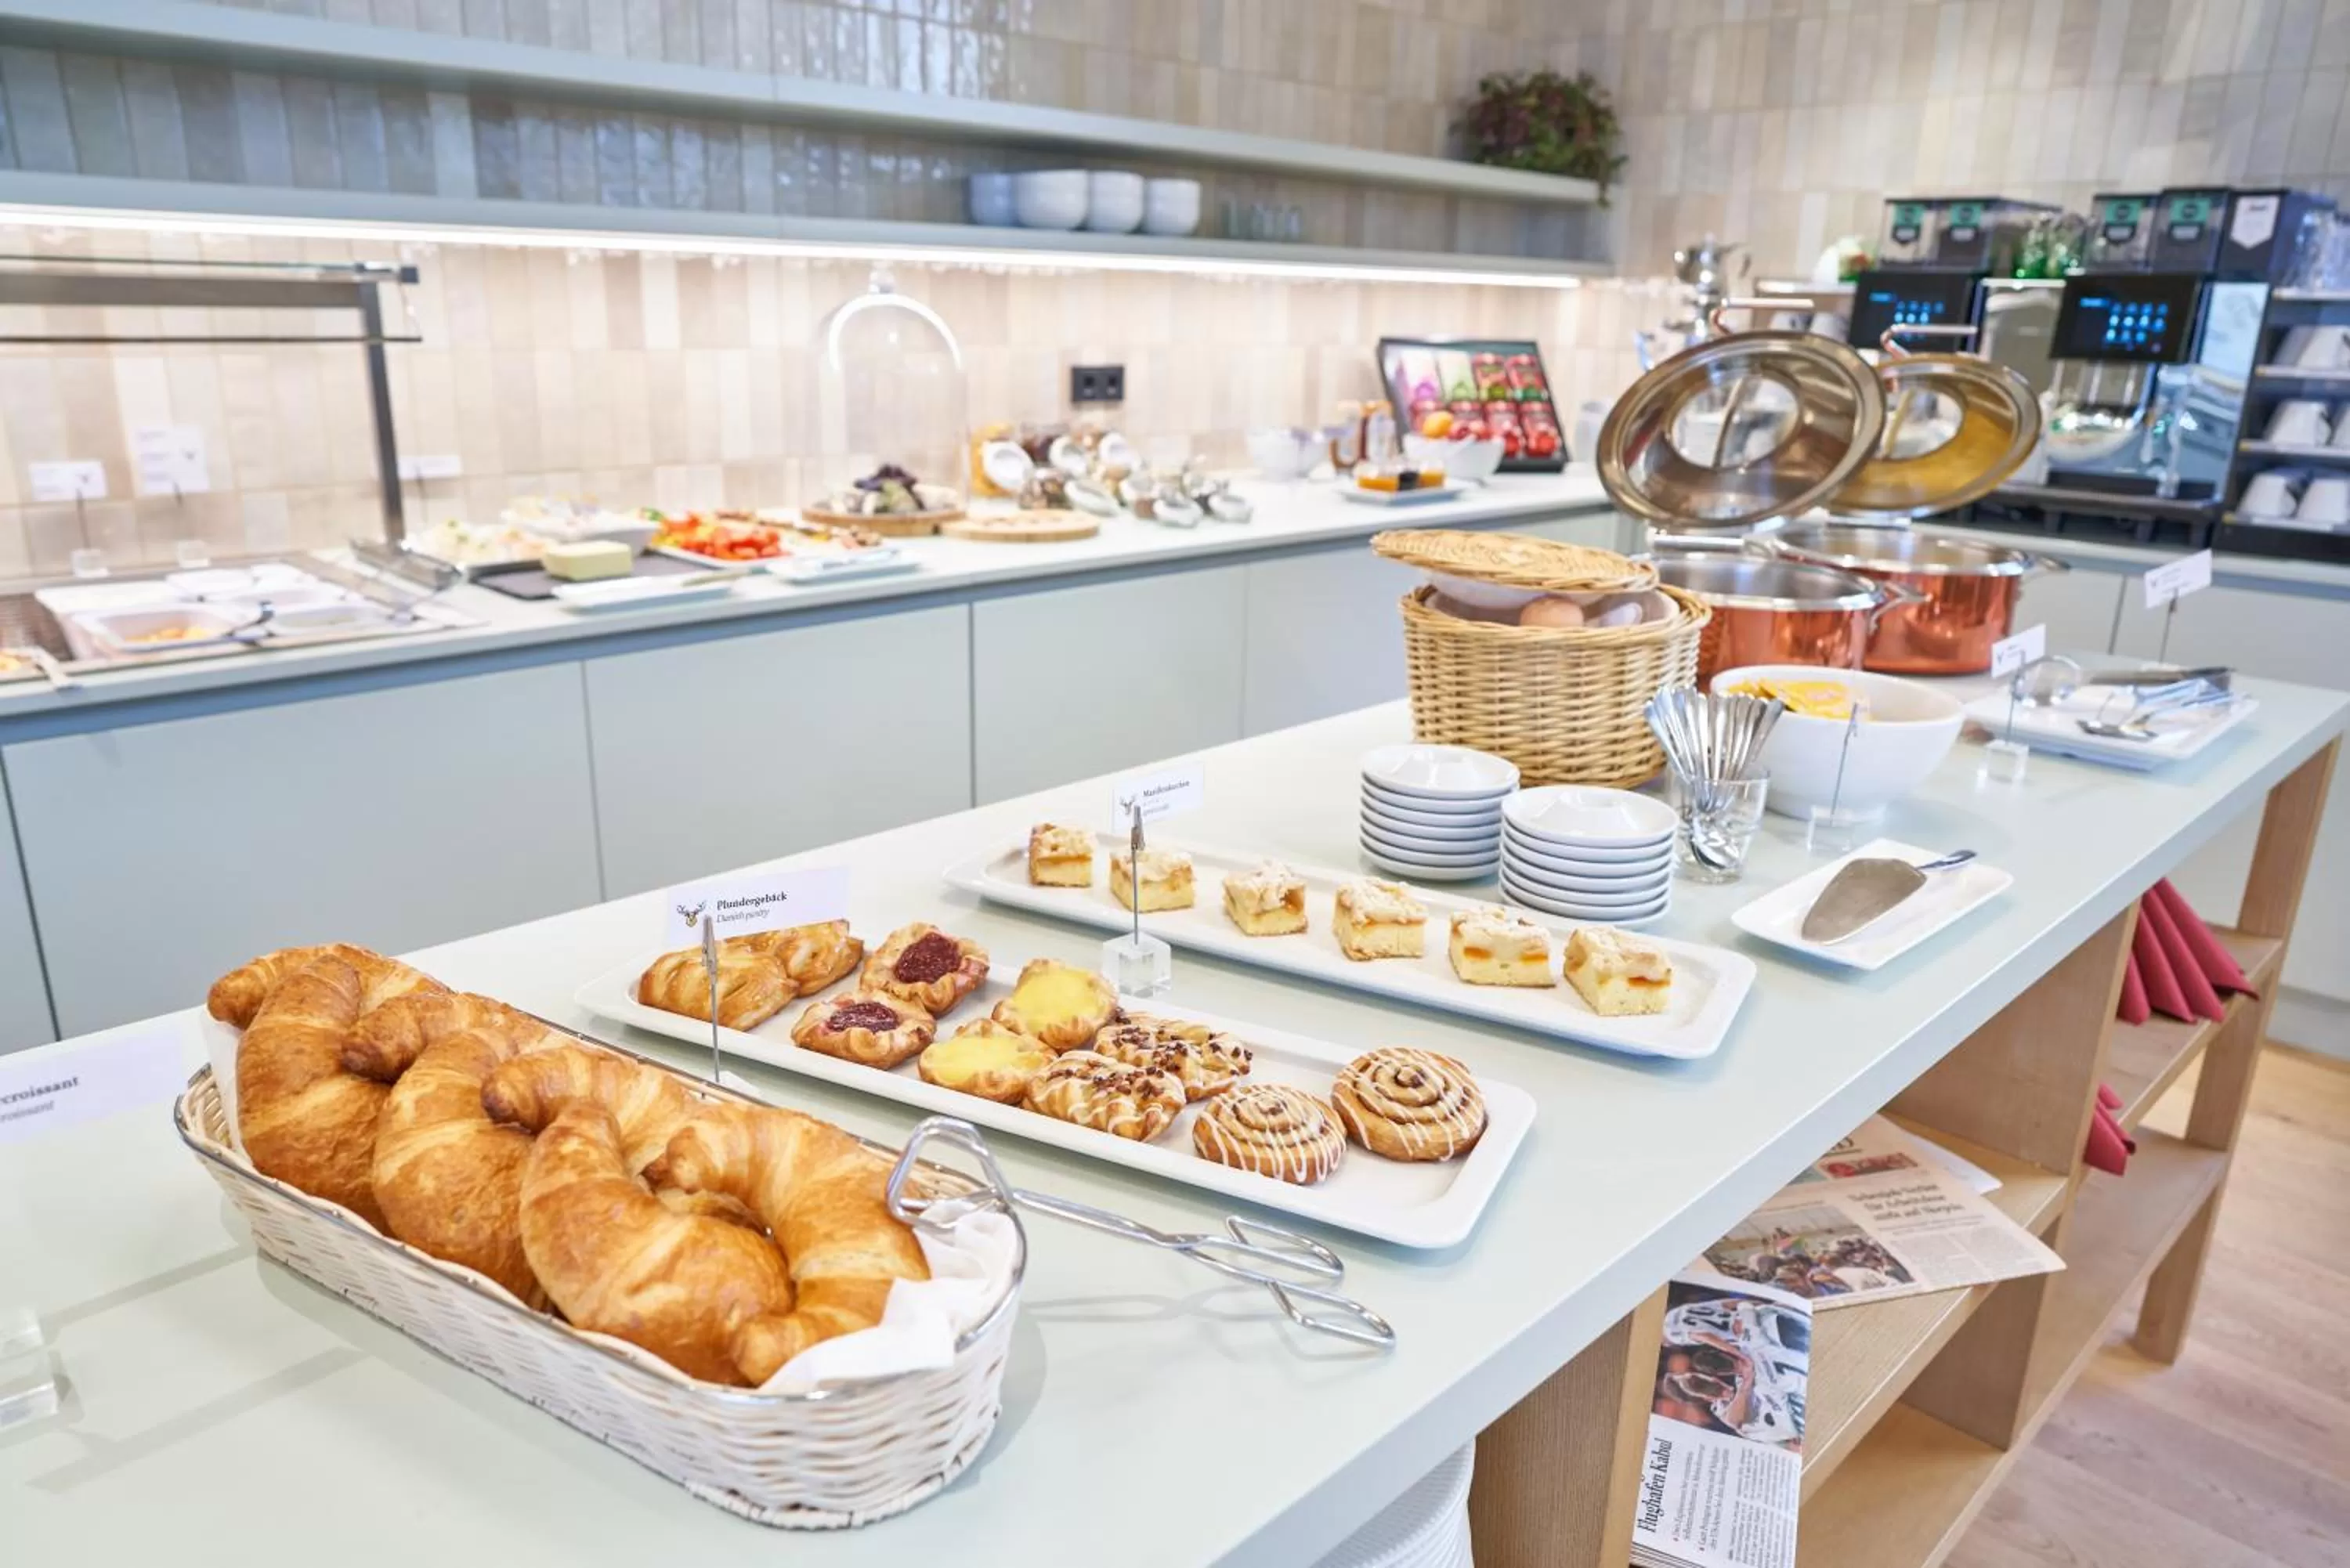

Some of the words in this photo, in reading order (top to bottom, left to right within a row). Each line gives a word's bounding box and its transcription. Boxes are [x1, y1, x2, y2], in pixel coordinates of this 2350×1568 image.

[717, 891, 787, 910] Plundergebäck
[1649, 1437, 1672, 1473] Kabul
[1636, 1473, 1666, 1533] Flughafen
